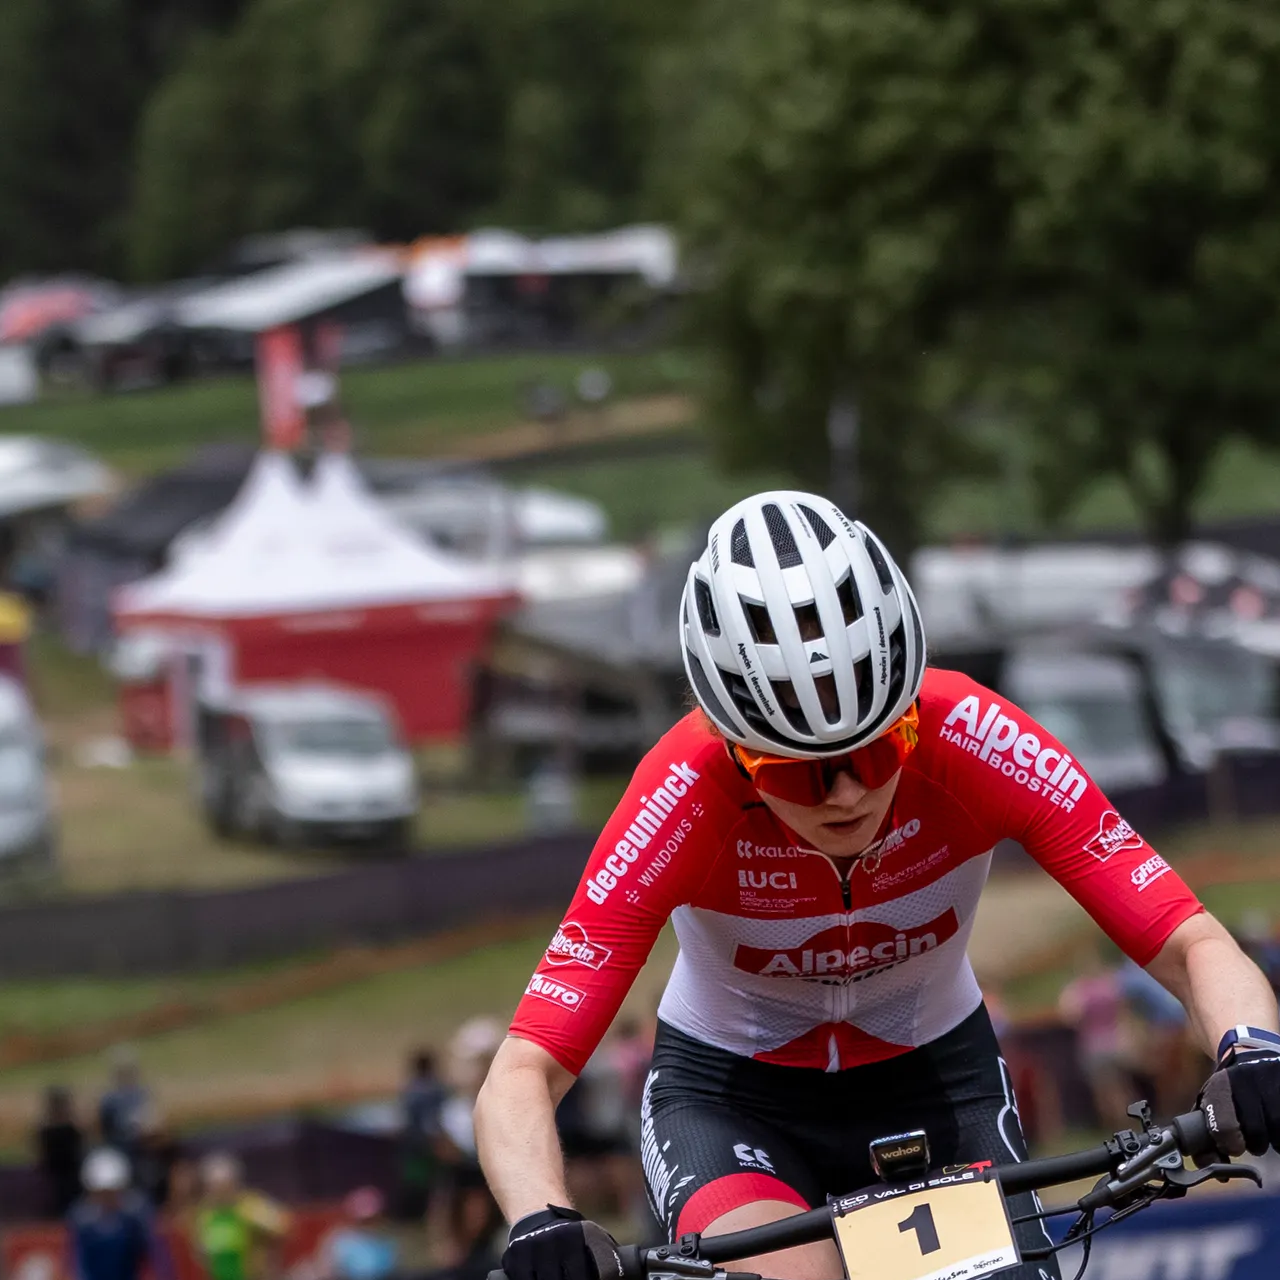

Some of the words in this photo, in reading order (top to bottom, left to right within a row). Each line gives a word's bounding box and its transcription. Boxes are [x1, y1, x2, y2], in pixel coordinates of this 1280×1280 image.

[737, 643, 752, 670] Alpecin
[750, 675, 775, 716] deceuninck
[939, 726, 980, 756] HAIR
[988, 754, 1076, 813] BOOSTER
[944, 695, 1088, 802] Alpecin
[586, 761, 700, 905] deceuninck
[638, 819, 693, 888] WINDOWS
[760, 932, 938, 975] Alpecin
[1206, 1104, 1219, 1132] OAKLEY
[880, 1145, 921, 1160] wahoo
[874, 1188, 906, 1199] VAL
[908, 1181, 926, 1191] DI
[928, 1171, 975, 1187] SOLE
[897, 1203, 941, 1256] 1
[973, 1256, 1004, 1270] TRENTINO
